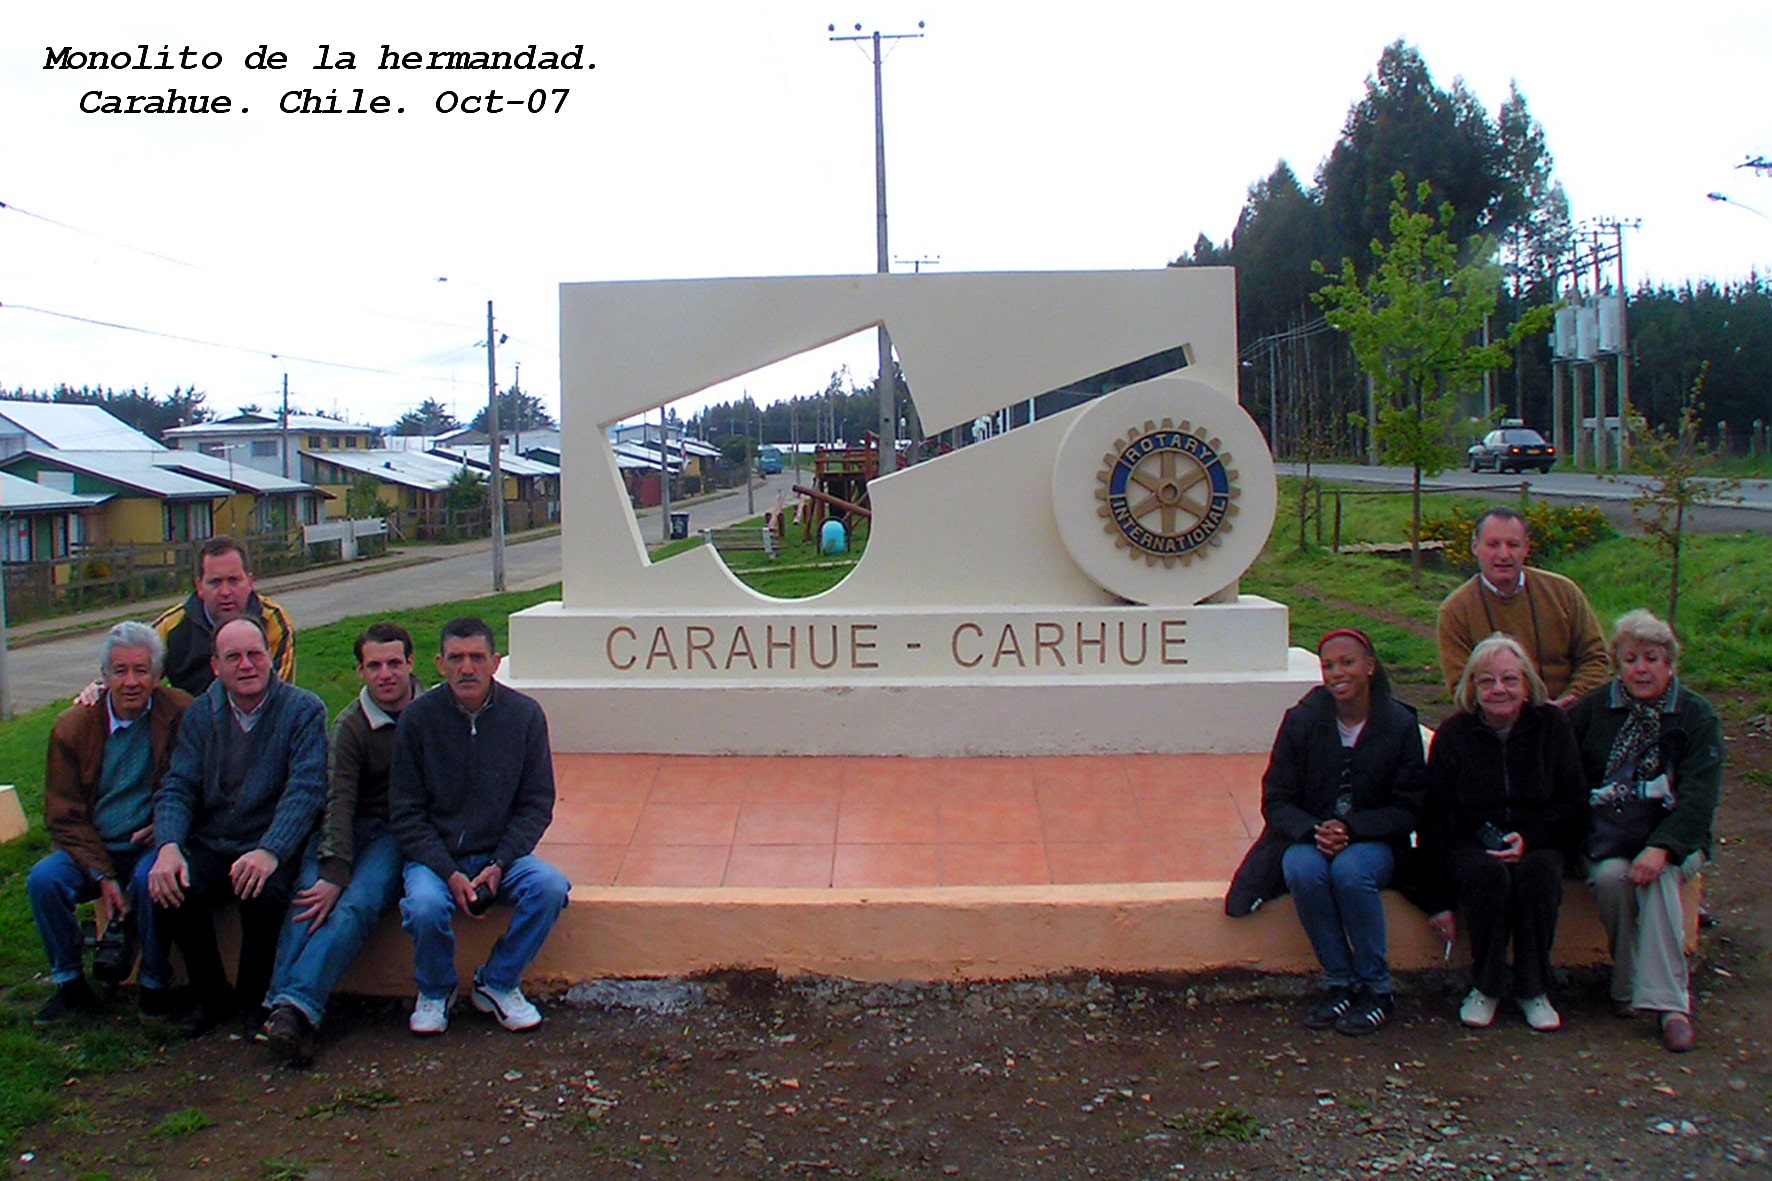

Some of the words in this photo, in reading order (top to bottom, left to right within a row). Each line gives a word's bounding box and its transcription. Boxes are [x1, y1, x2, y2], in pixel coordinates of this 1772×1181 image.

[1125, 433, 1213, 463] ROTARY
[1112, 499, 1227, 552] INTERNATIONAL
[605, 623, 880, 672] CARAHUE
[950, 619, 1190, 668] CARHUE
